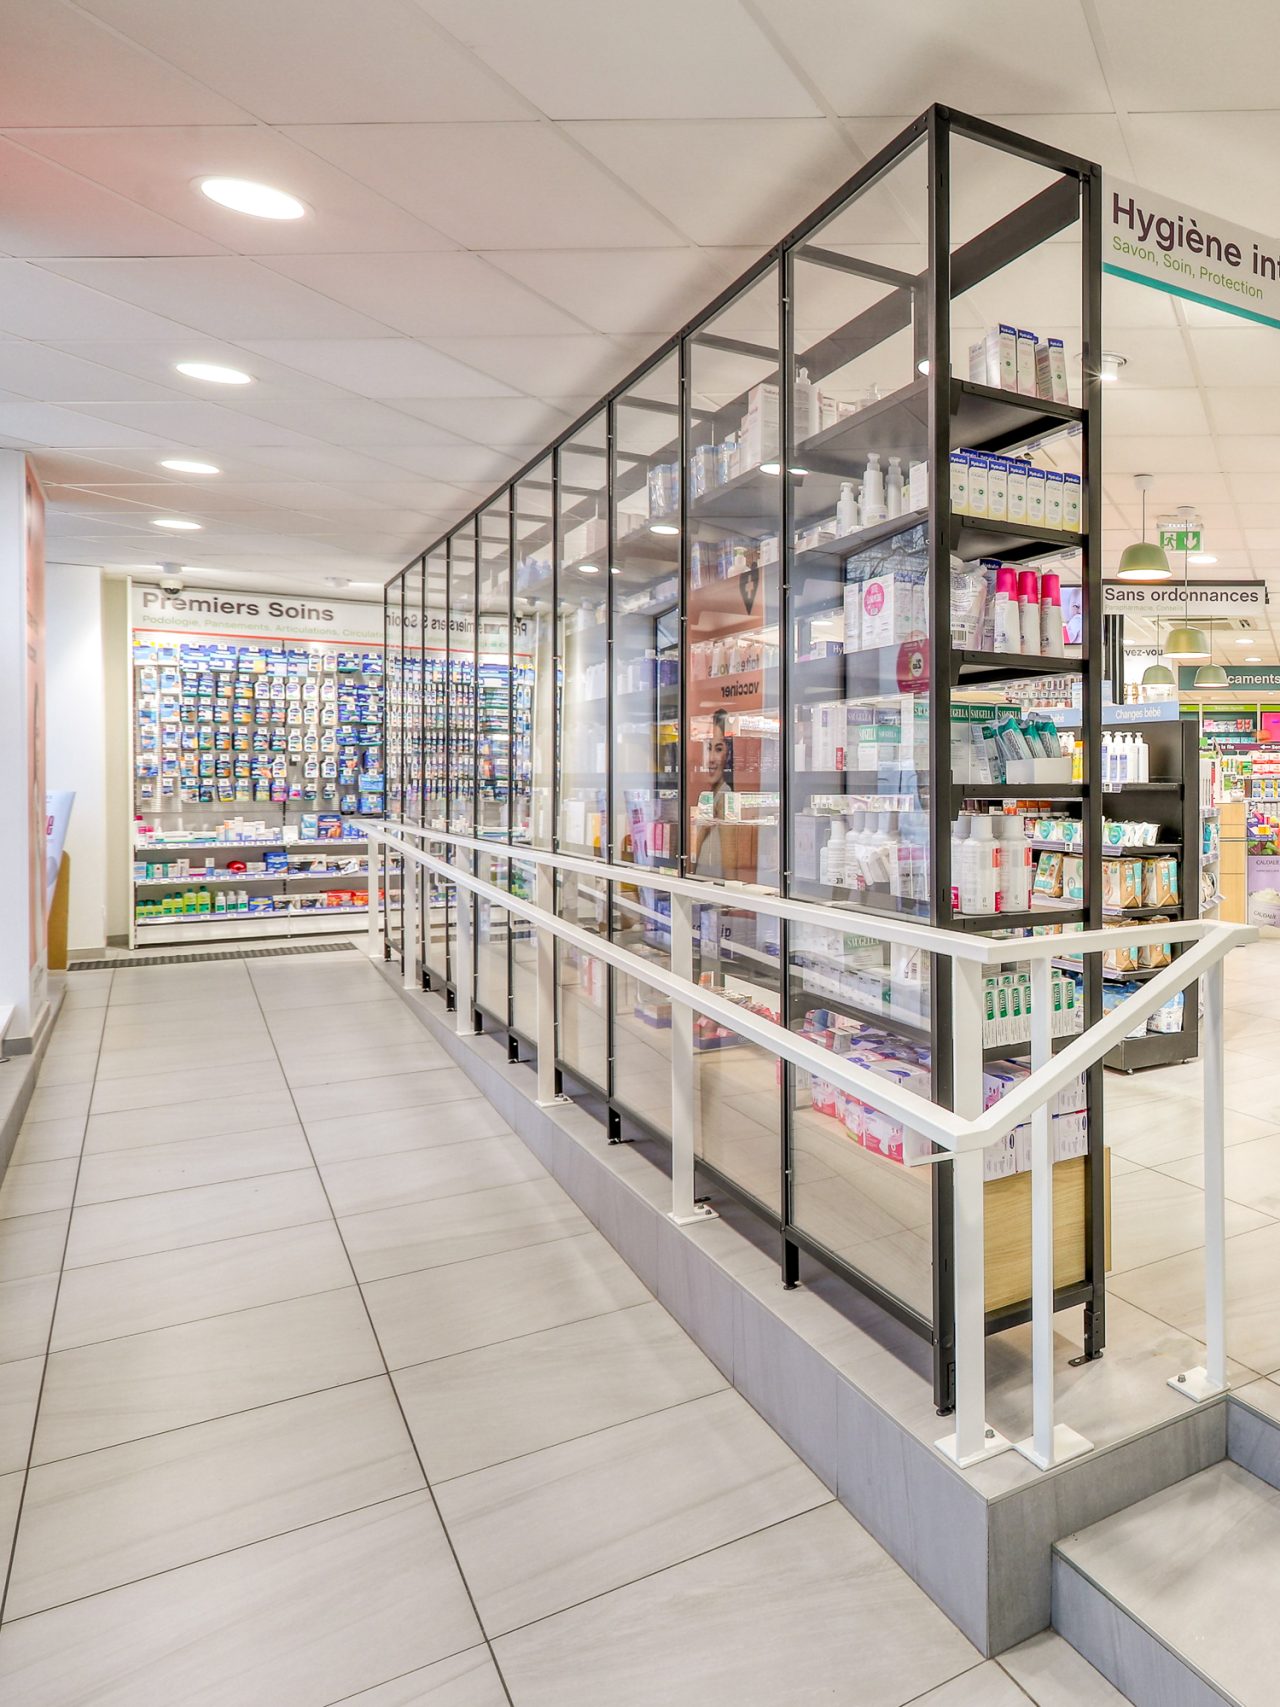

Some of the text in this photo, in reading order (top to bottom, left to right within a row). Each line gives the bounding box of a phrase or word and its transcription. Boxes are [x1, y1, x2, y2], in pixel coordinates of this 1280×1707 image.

[1113, 191, 1242, 268] Hygiène
[1112, 235, 1263, 300] Savon, Soin, Protection
[1105, 587, 1259, 603] Sans ordonnances
[143, 592, 334, 622] Premiers Soins
[143, 615, 201, 627] Podologie,
[204, 619, 272, 632] Pansements,
[275, 624, 341, 636] Articulations,
[970, 706, 994, 718] SAUGELLA
[1115, 706, 1161, 720] Changes bébé
